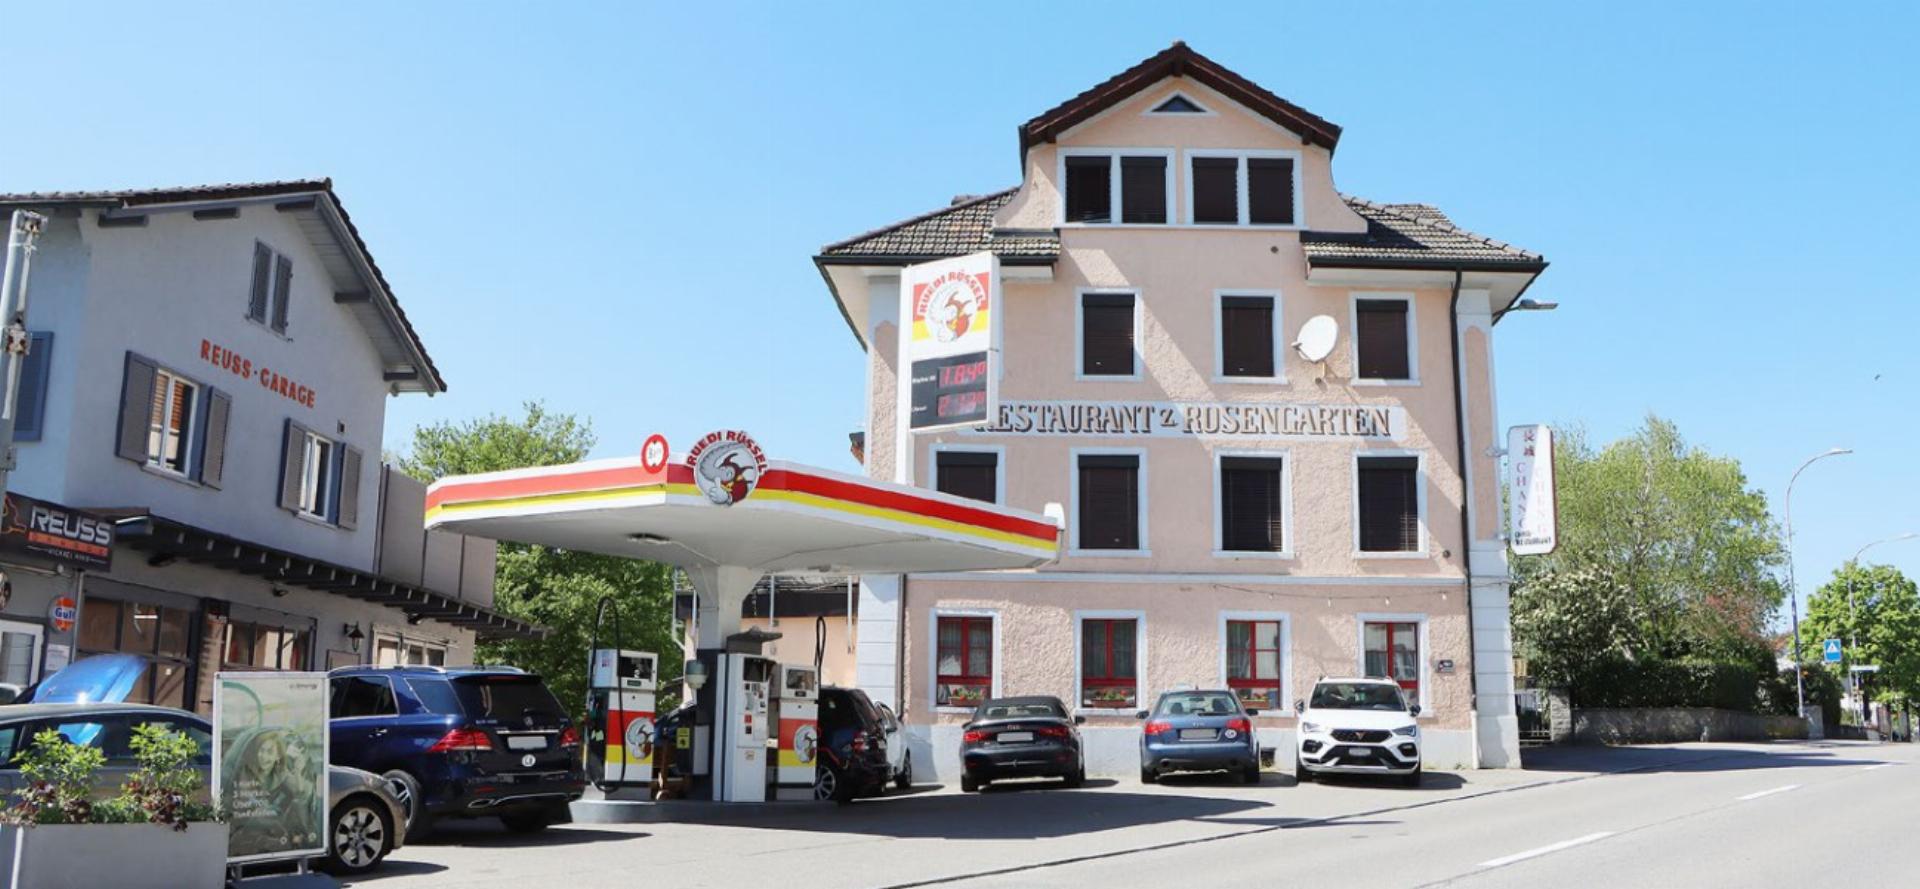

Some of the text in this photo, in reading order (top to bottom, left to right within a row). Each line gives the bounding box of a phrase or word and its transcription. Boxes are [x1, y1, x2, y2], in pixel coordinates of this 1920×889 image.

[200, 338, 252, 379] REUSS
[260, 367, 316, 409] GARAGE
[974, 404, 1155, 433] ESTAURANT
[1182, 405, 1392, 437] ROSENGARTEN
[686, 428, 767, 475] RUEDI RÜSSEL
[30, 505, 112, 545] REUSS
